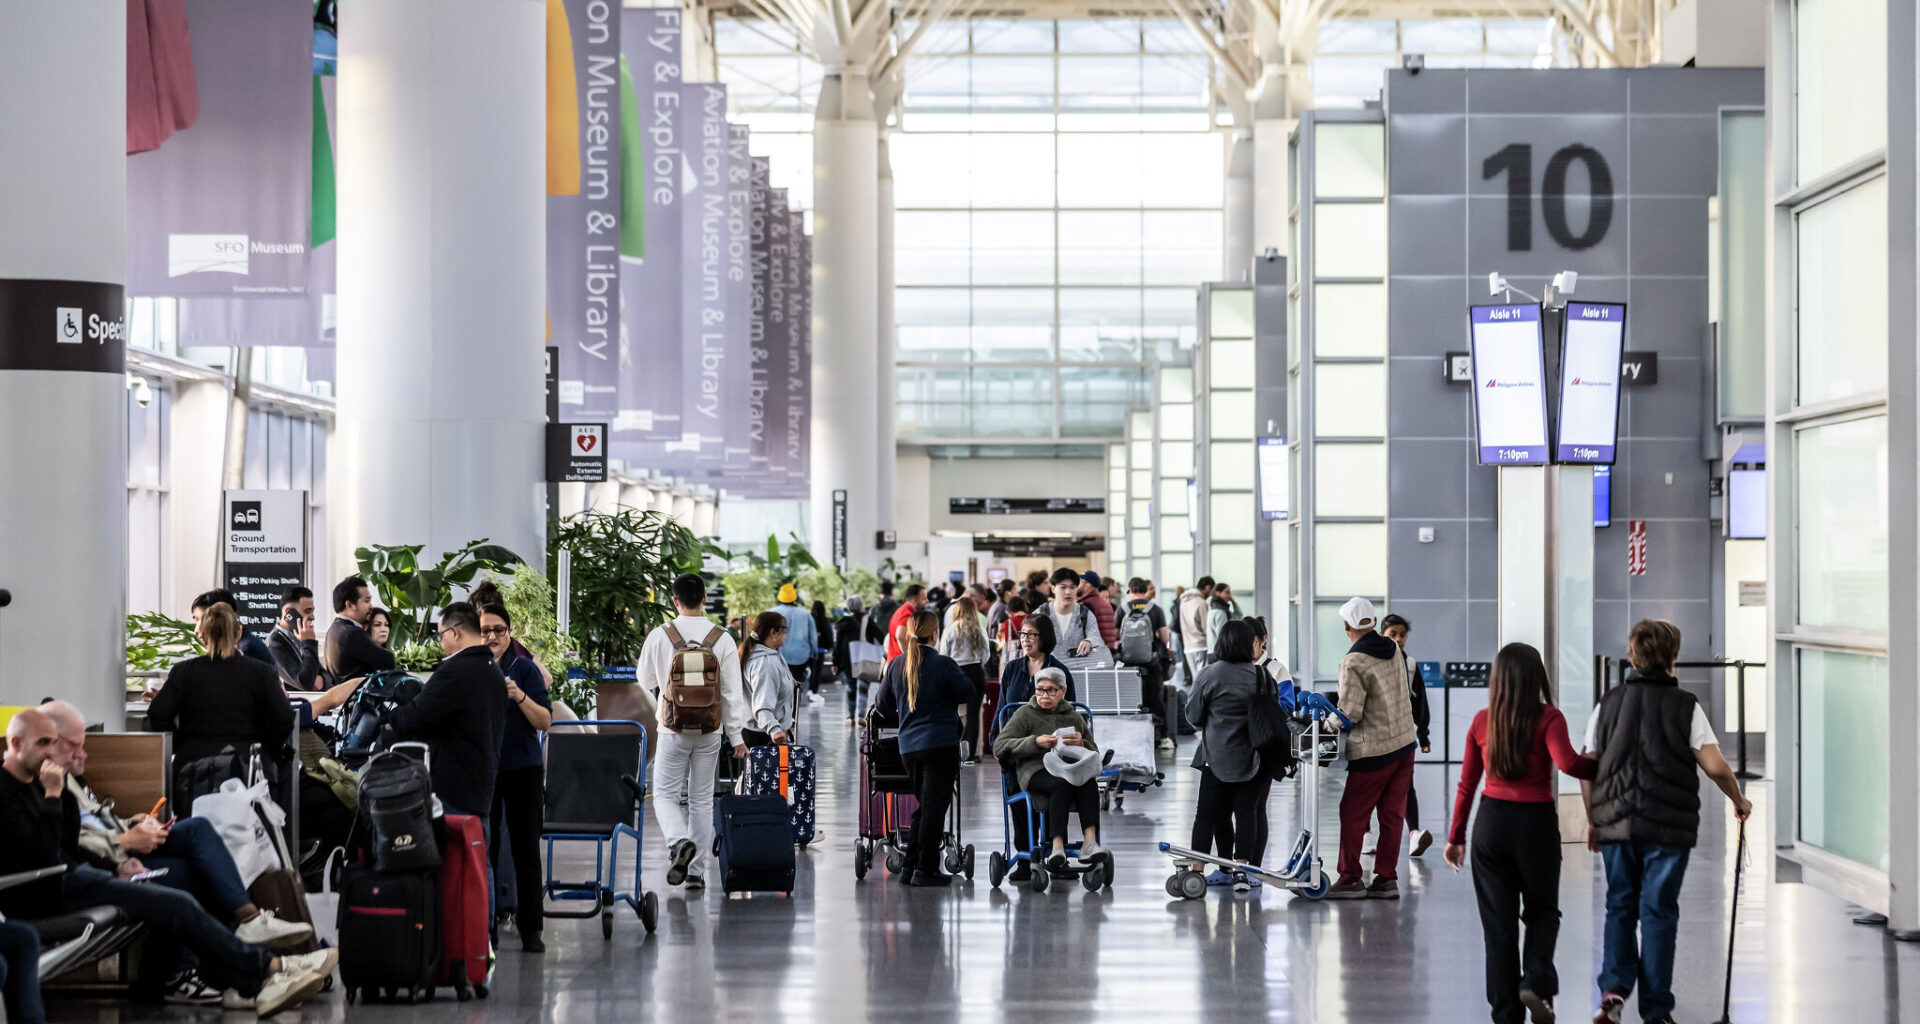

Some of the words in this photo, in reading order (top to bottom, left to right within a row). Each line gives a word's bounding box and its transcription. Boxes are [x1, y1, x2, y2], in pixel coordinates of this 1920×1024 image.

[648, 10, 680, 53] Fly
[654, 61, 680, 82] &
[586, 55, 616, 200] Museum
[703, 85, 725, 187] Aviation
[648, 92, 680, 205] Explore
[729, 126, 749, 160] Fly
[728, 165, 749, 184] &
[1482, 143, 1614, 251] 10
[586, 210, 616, 235] &
[214, 241, 244, 254] SFO
[250, 241, 305, 254] Museum
[703, 194, 725, 301] Museum
[728, 190, 749, 282] Explore
[578, 246, 617, 360] Library
[1489, 308, 1510, 320] Aisle
[1511, 308, 1521, 319] 11
[1582, 306, 1600, 318] Aisle
[1601, 307, 1609, 318] 11
[703, 308, 725, 326] &
[696, 333, 725, 419] Library
[1499, 449, 1529, 461] 7:10pm
[1573, 448, 1599, 460] 7:10pm
[230, 534, 265, 543] Ground
[231, 545, 296, 554] Transportation
[261, 577, 280, 586] Parking
